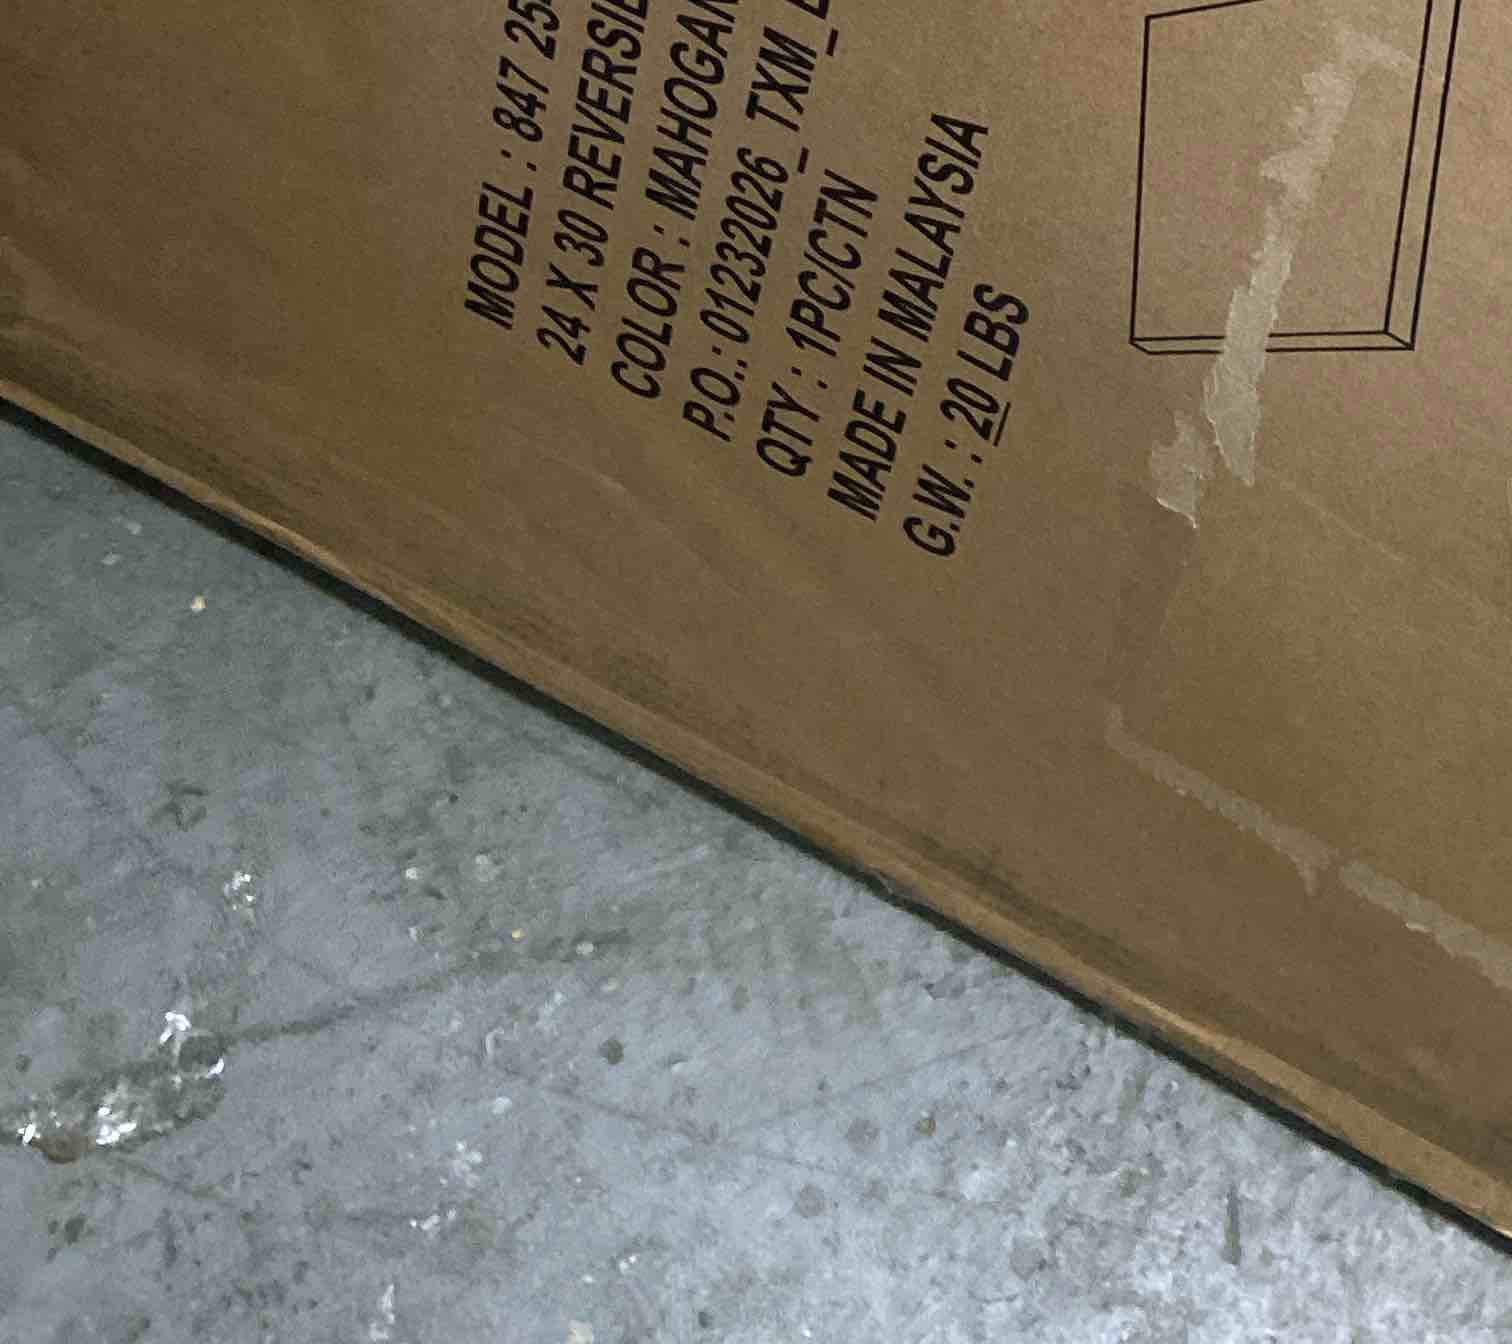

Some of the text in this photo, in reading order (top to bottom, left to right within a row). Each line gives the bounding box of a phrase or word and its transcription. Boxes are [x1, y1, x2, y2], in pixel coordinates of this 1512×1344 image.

[492, 57, 550, 142] 847
[464, 181, 534, 332] MODEL
[553, 210, 609, 267] 30
[785, 169, 879, 358] 1PC/CTN
[536, 303, 591, 366] 24
[546, 265, 598, 310] X
[610, 247, 686, 400] COLOR
[826, 113, 989, 522] MADE IN MALAYSIA
[957, 284, 1029, 382] LBS
[755, 382, 820, 478] QTY
[939, 376, 994, 446] 20
[902, 464, 975, 559] G.W.
